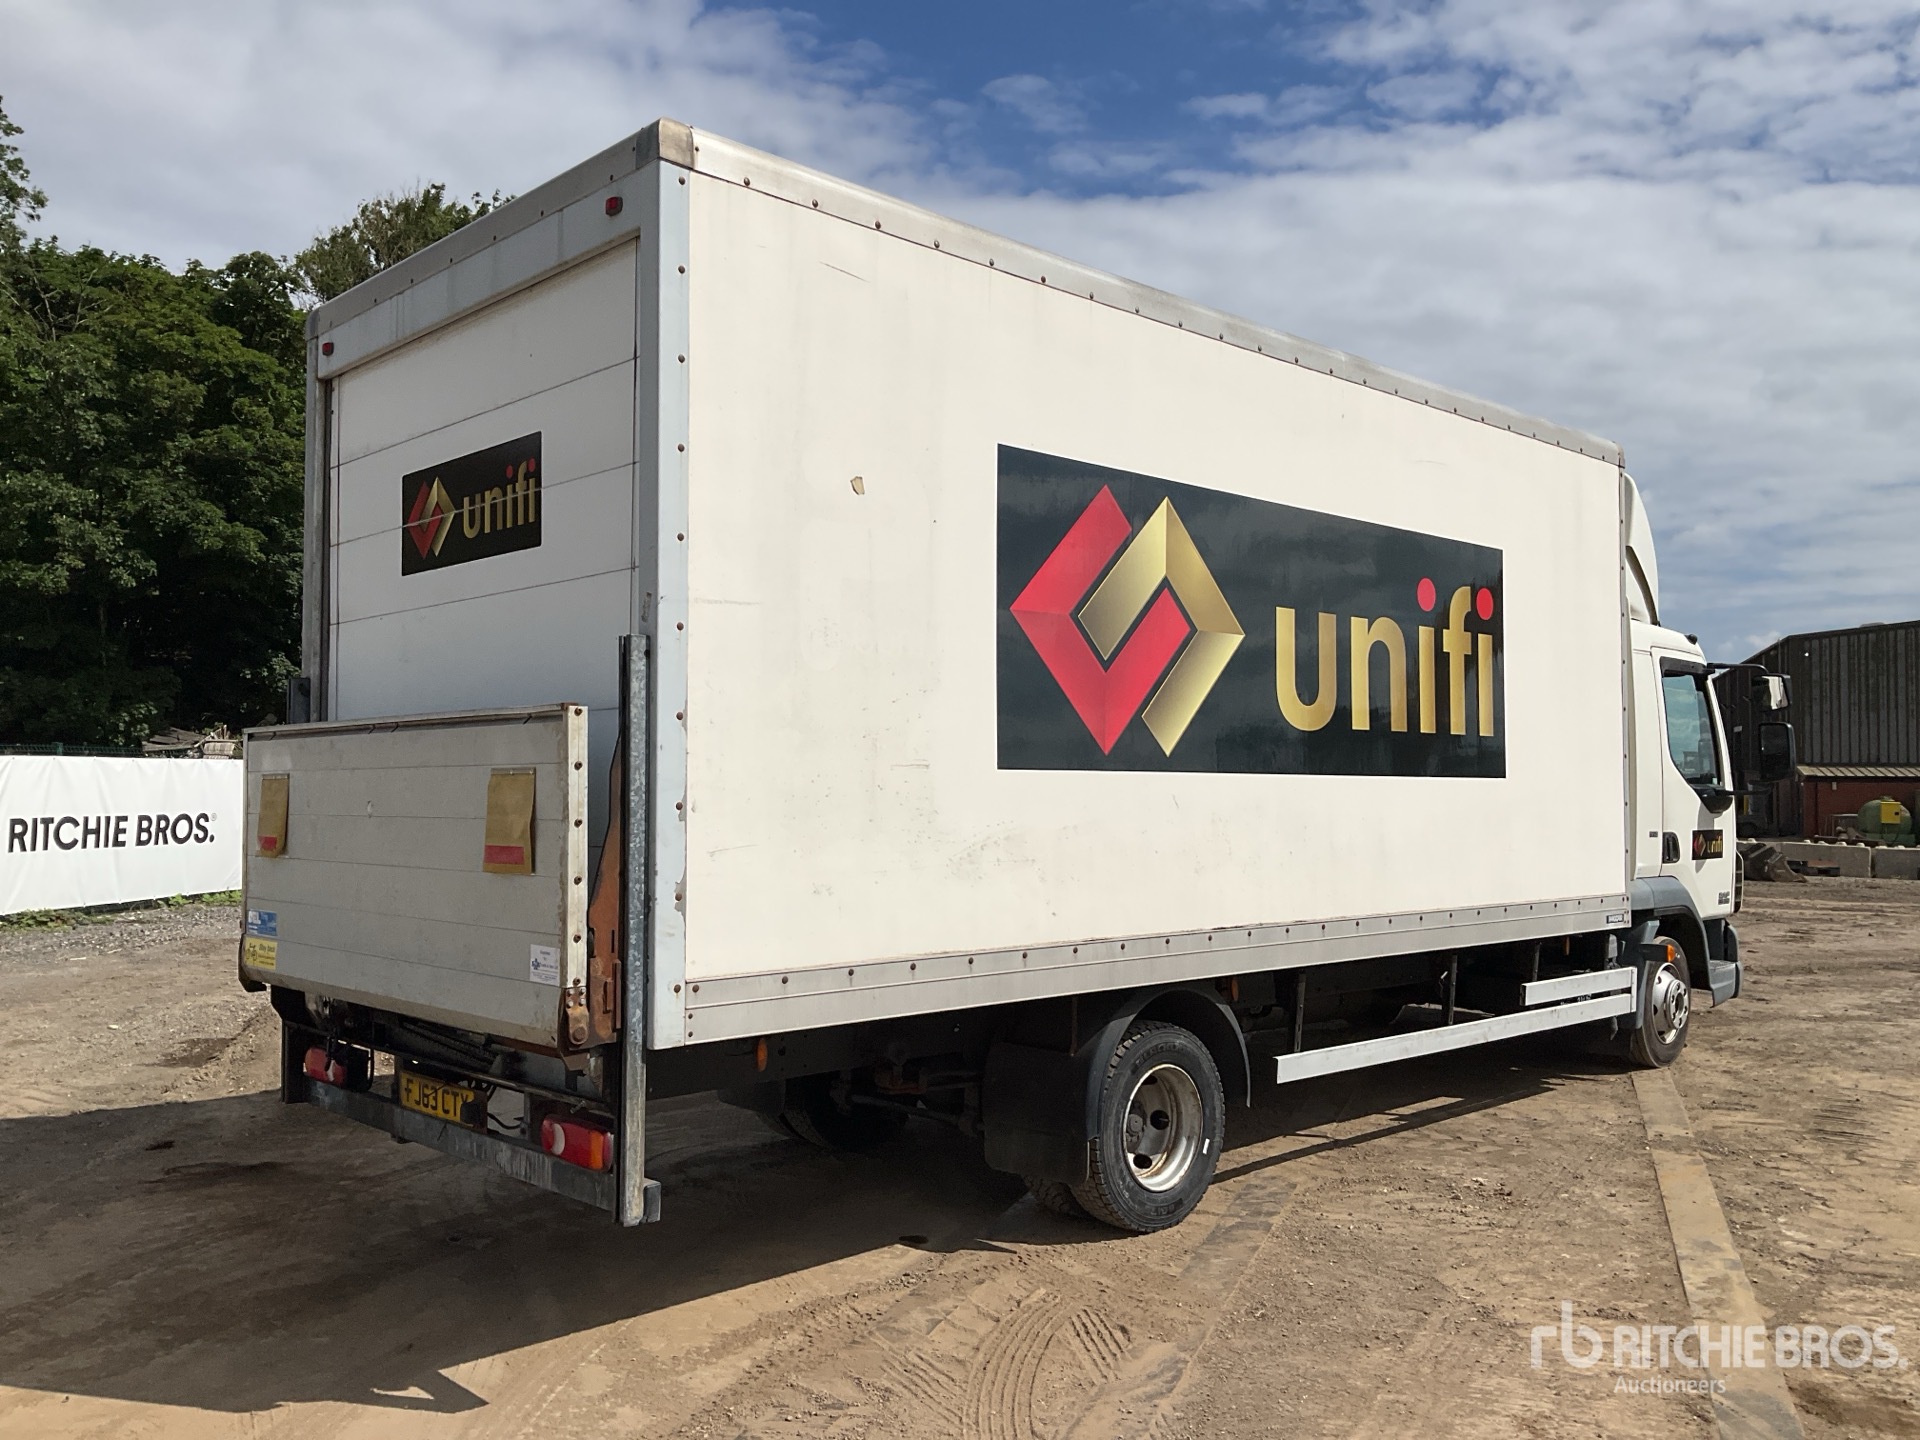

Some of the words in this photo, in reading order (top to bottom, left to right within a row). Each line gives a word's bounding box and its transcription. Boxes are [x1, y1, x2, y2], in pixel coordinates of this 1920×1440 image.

[463, 457, 537, 539] unifi
[1275, 577, 1495, 737] unifi
[8, 815, 129, 853] RITCHIE
[135, 812, 215, 847] BROS.
